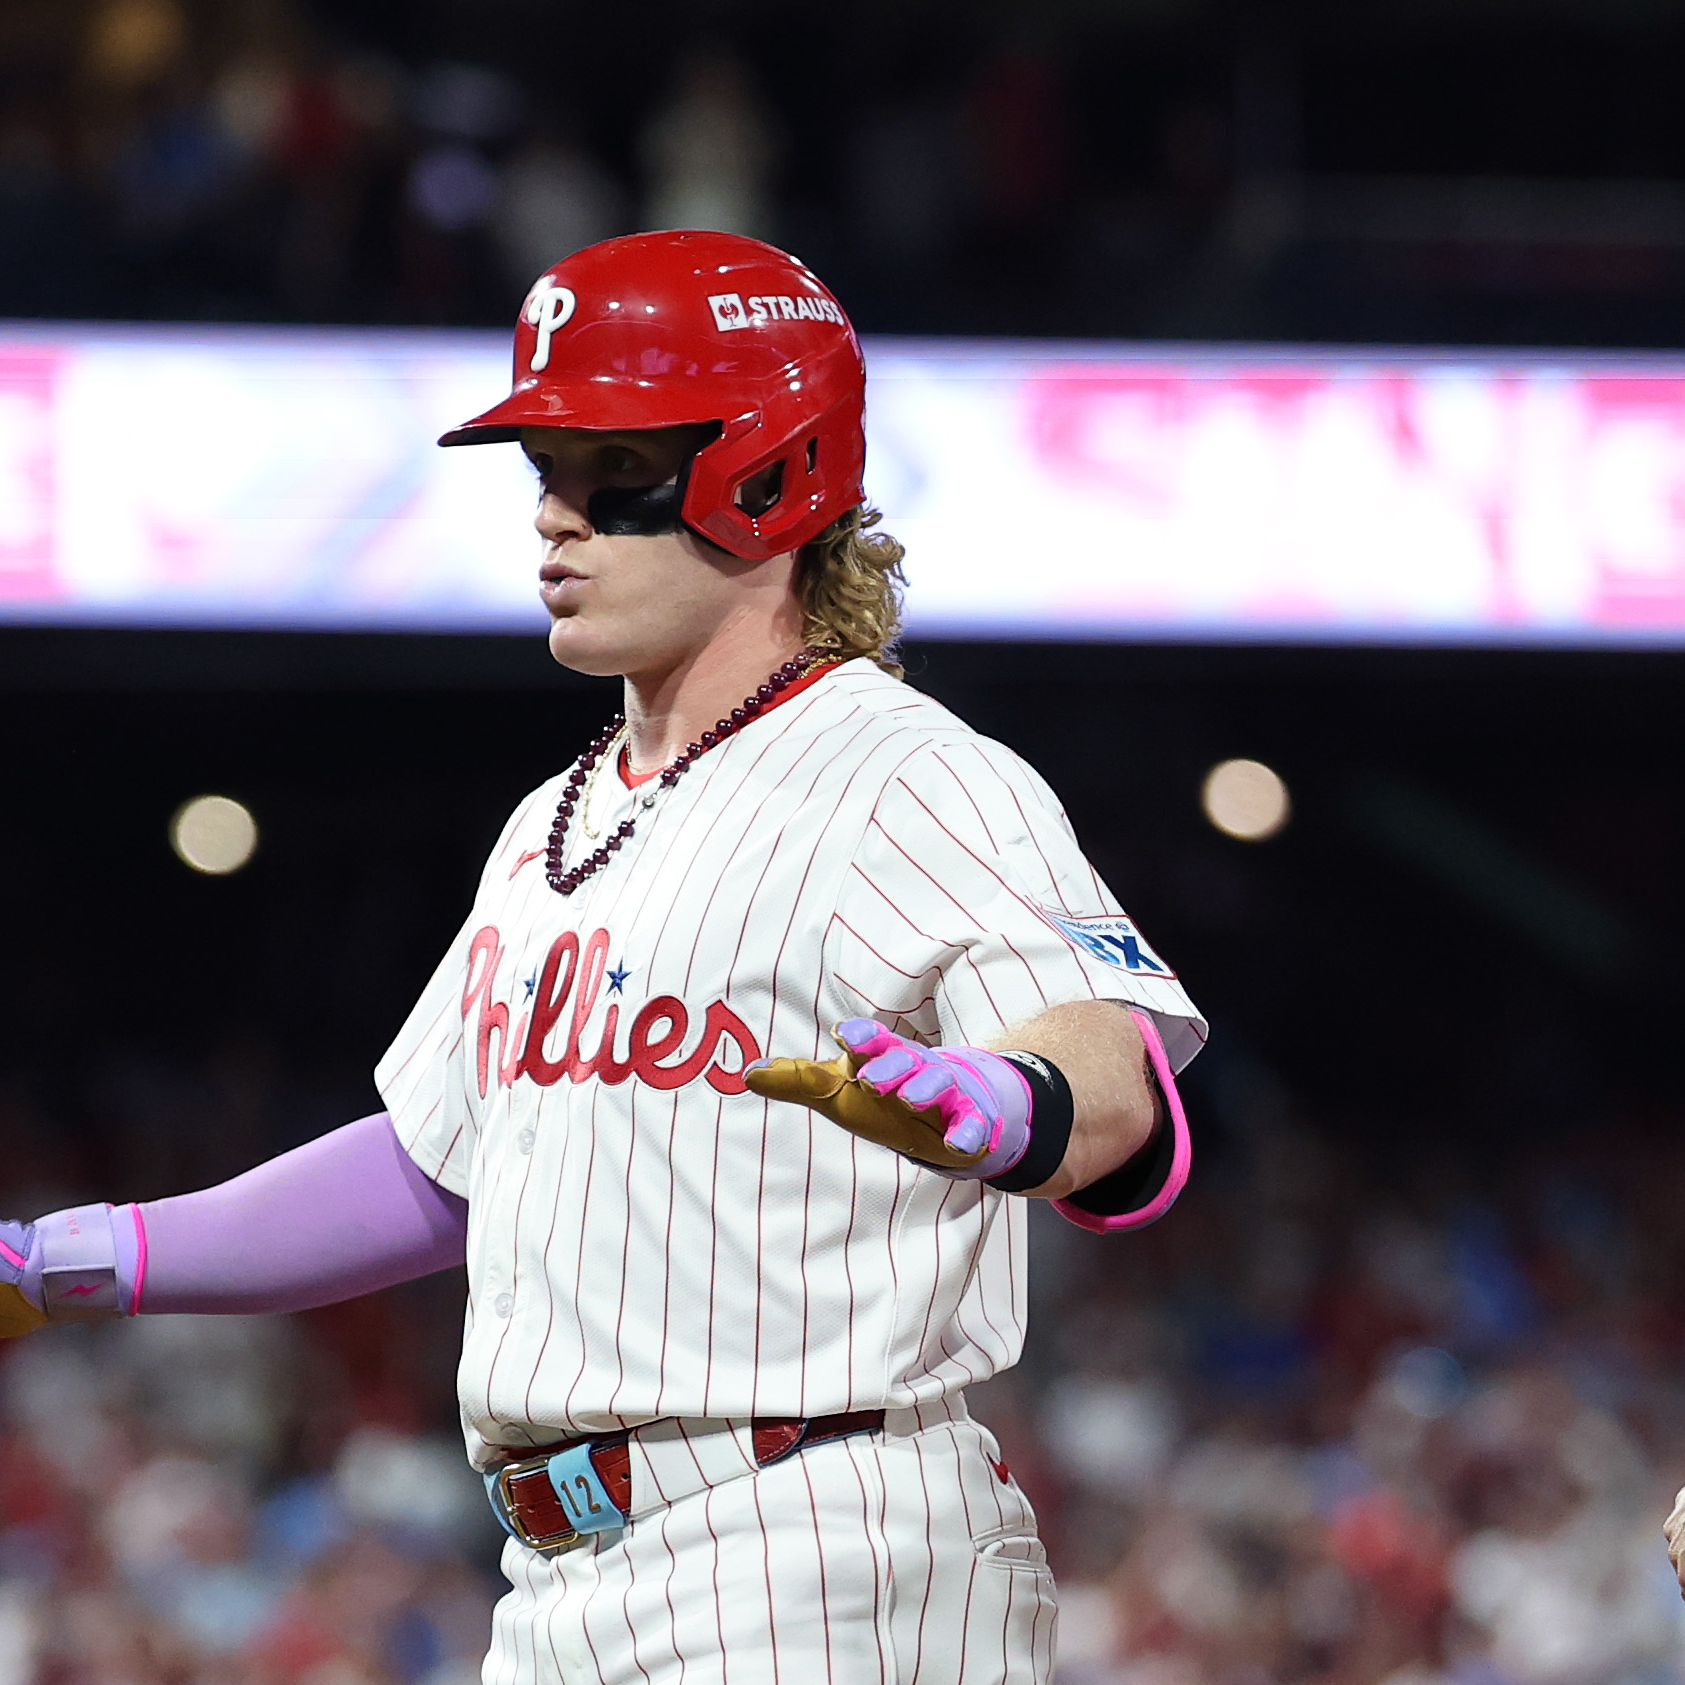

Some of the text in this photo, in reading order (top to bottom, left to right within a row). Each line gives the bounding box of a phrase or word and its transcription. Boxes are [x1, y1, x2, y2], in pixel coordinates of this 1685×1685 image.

[527, 287, 576, 372] P
[748, 296, 845, 326] STRAUSS
[560, 1474, 602, 1518] 12
